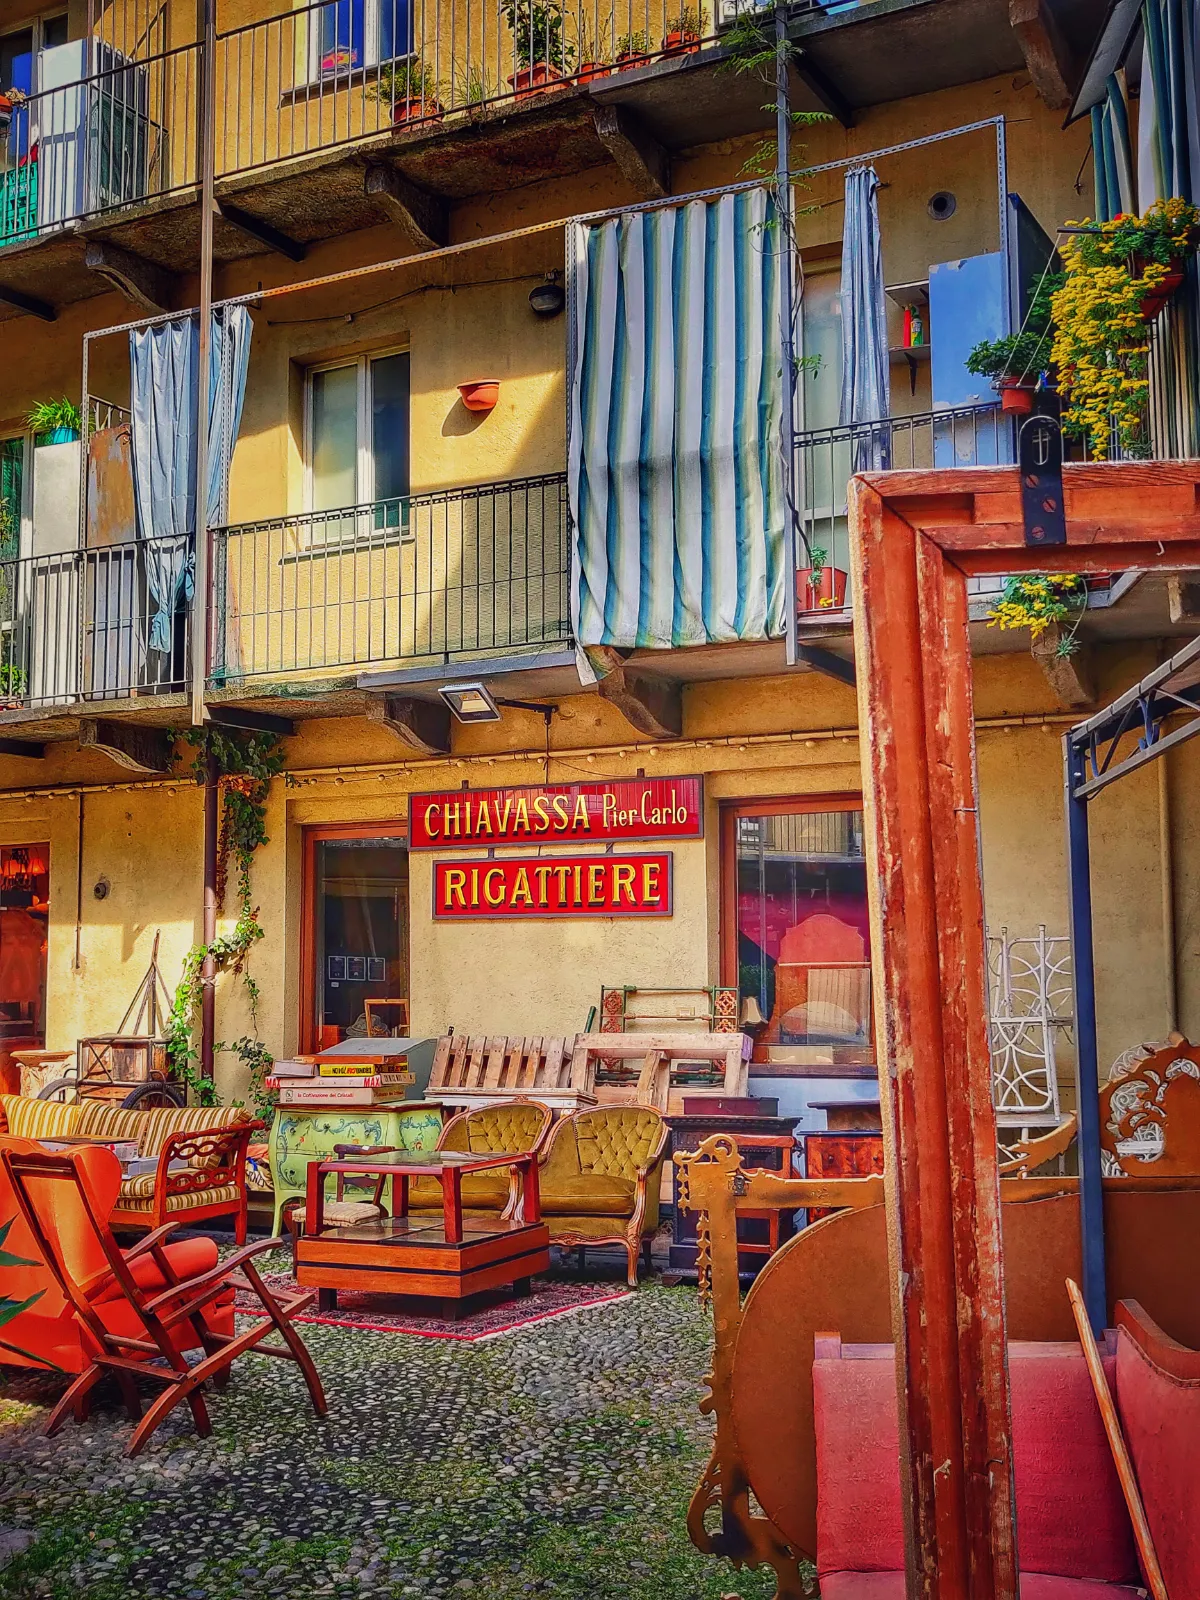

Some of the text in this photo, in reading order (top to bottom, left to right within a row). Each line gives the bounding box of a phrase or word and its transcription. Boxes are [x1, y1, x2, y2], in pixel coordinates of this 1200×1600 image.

[424, 790, 687, 839] CHIAVASSA Pier Carlo
[444, 863, 661, 908] RIGATTIERE
[265, 1078, 281, 1088] MAX
[363, 1077, 381, 1087] MAX
